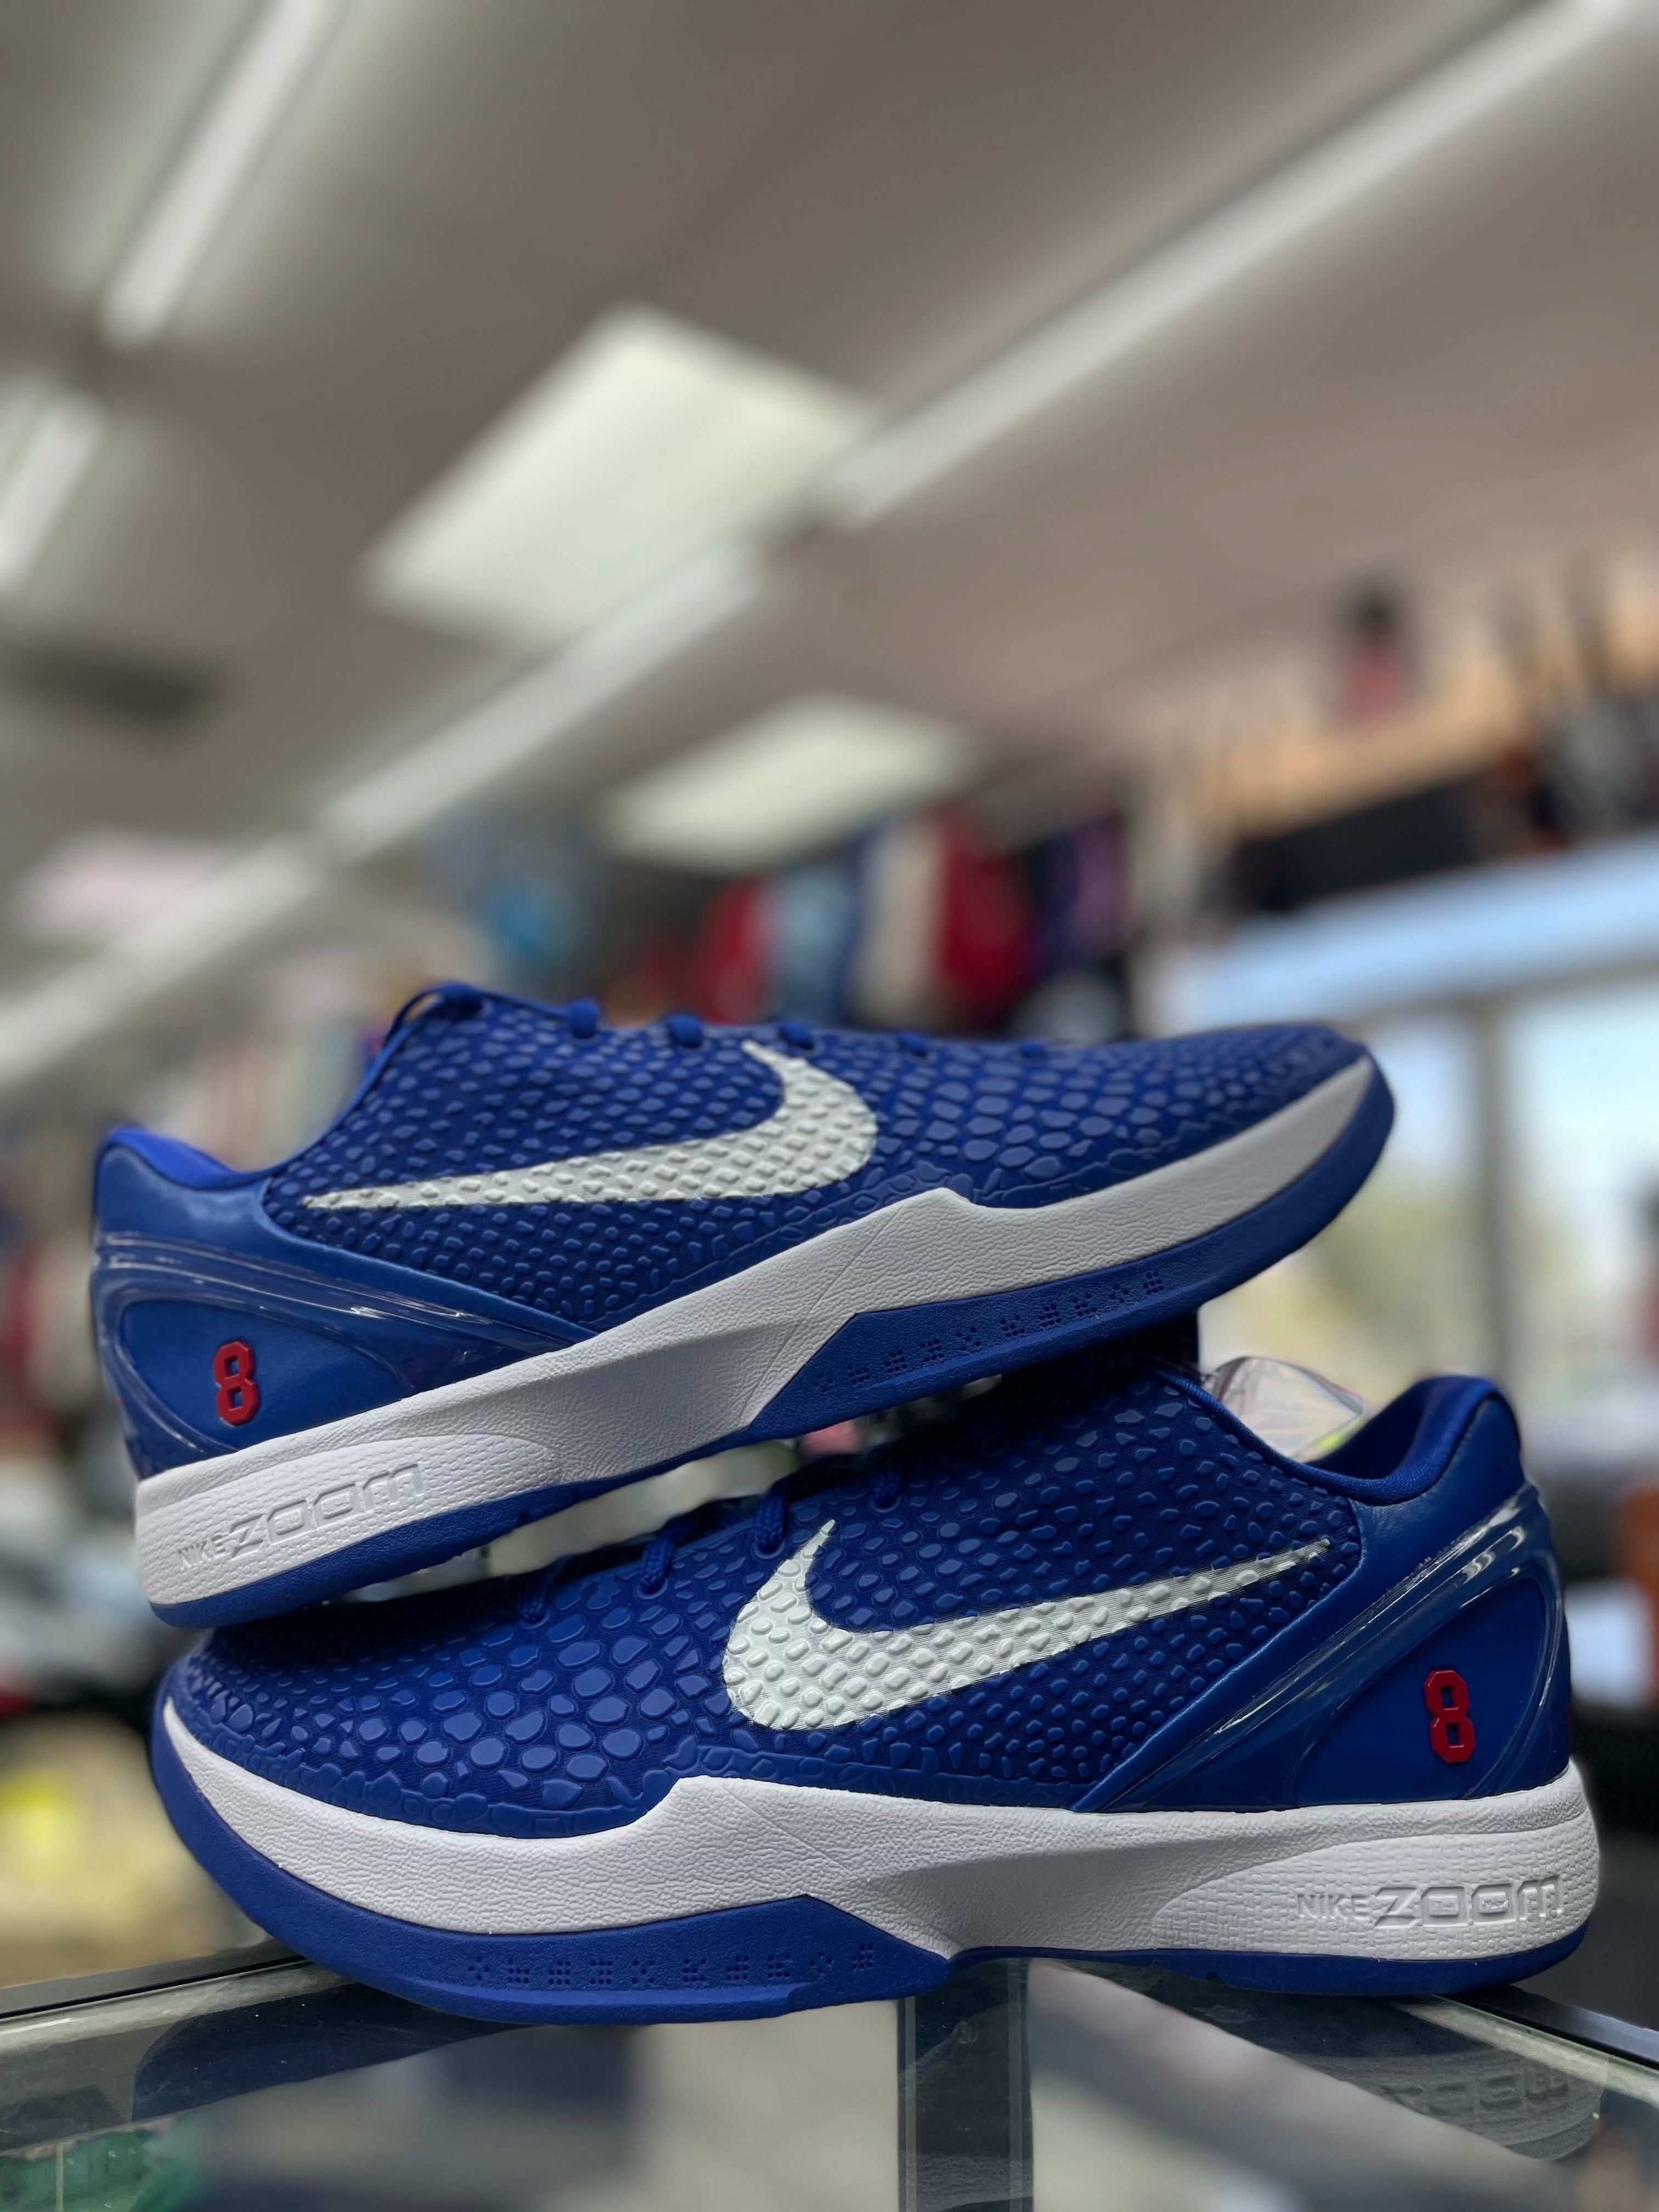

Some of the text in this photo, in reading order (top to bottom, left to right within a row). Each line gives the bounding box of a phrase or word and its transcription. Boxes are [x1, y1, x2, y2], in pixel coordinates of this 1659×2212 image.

[213, 1340, 259, 1426] 8
[178, 1536, 233, 1569] NIKE
[1424, 1669, 1476, 1763] 8
[1297, 1893, 1371, 1920] NIKE
